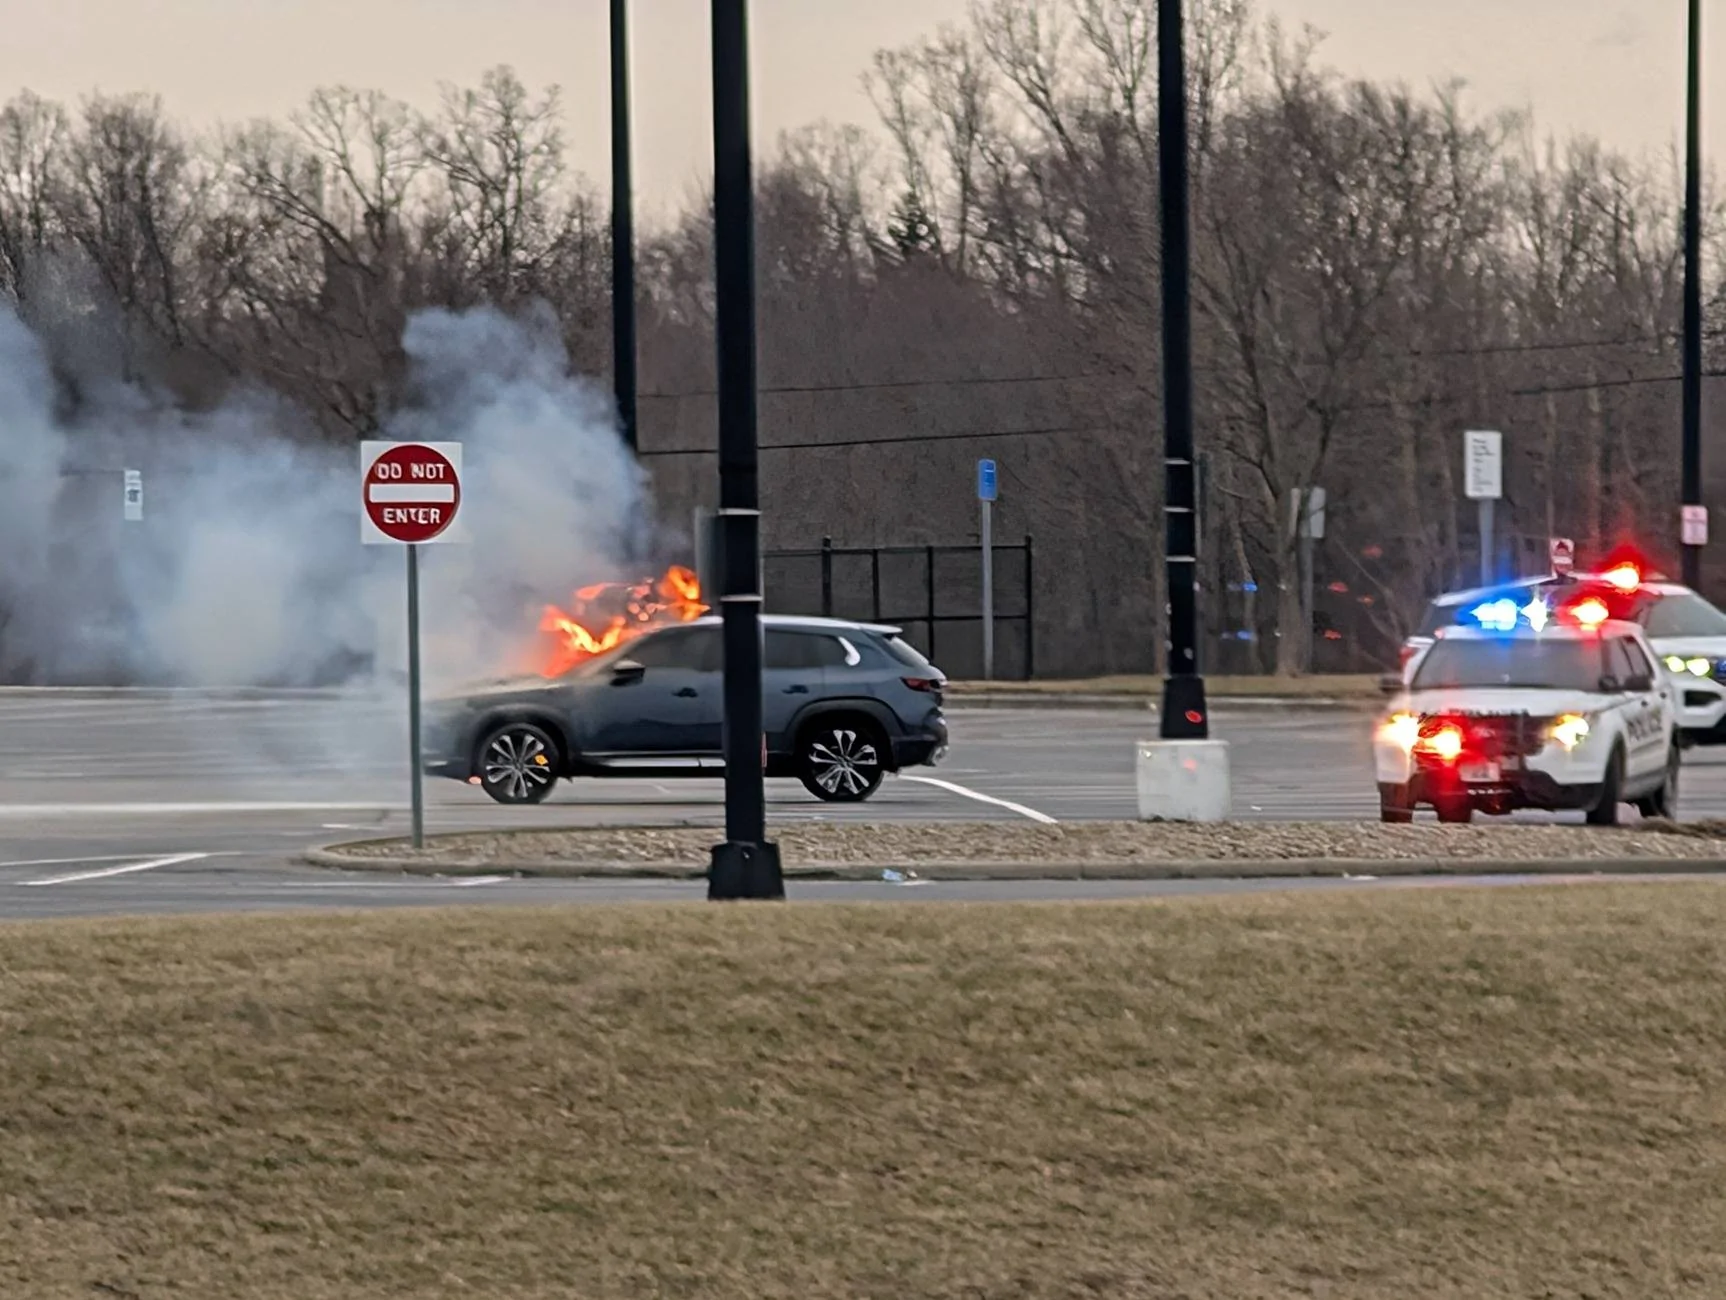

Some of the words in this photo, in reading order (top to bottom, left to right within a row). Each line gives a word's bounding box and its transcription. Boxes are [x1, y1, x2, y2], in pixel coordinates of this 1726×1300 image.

[377, 462, 402, 479] DO
[410, 462, 446, 479] NOT
[382, 507, 440, 524] ENTER
